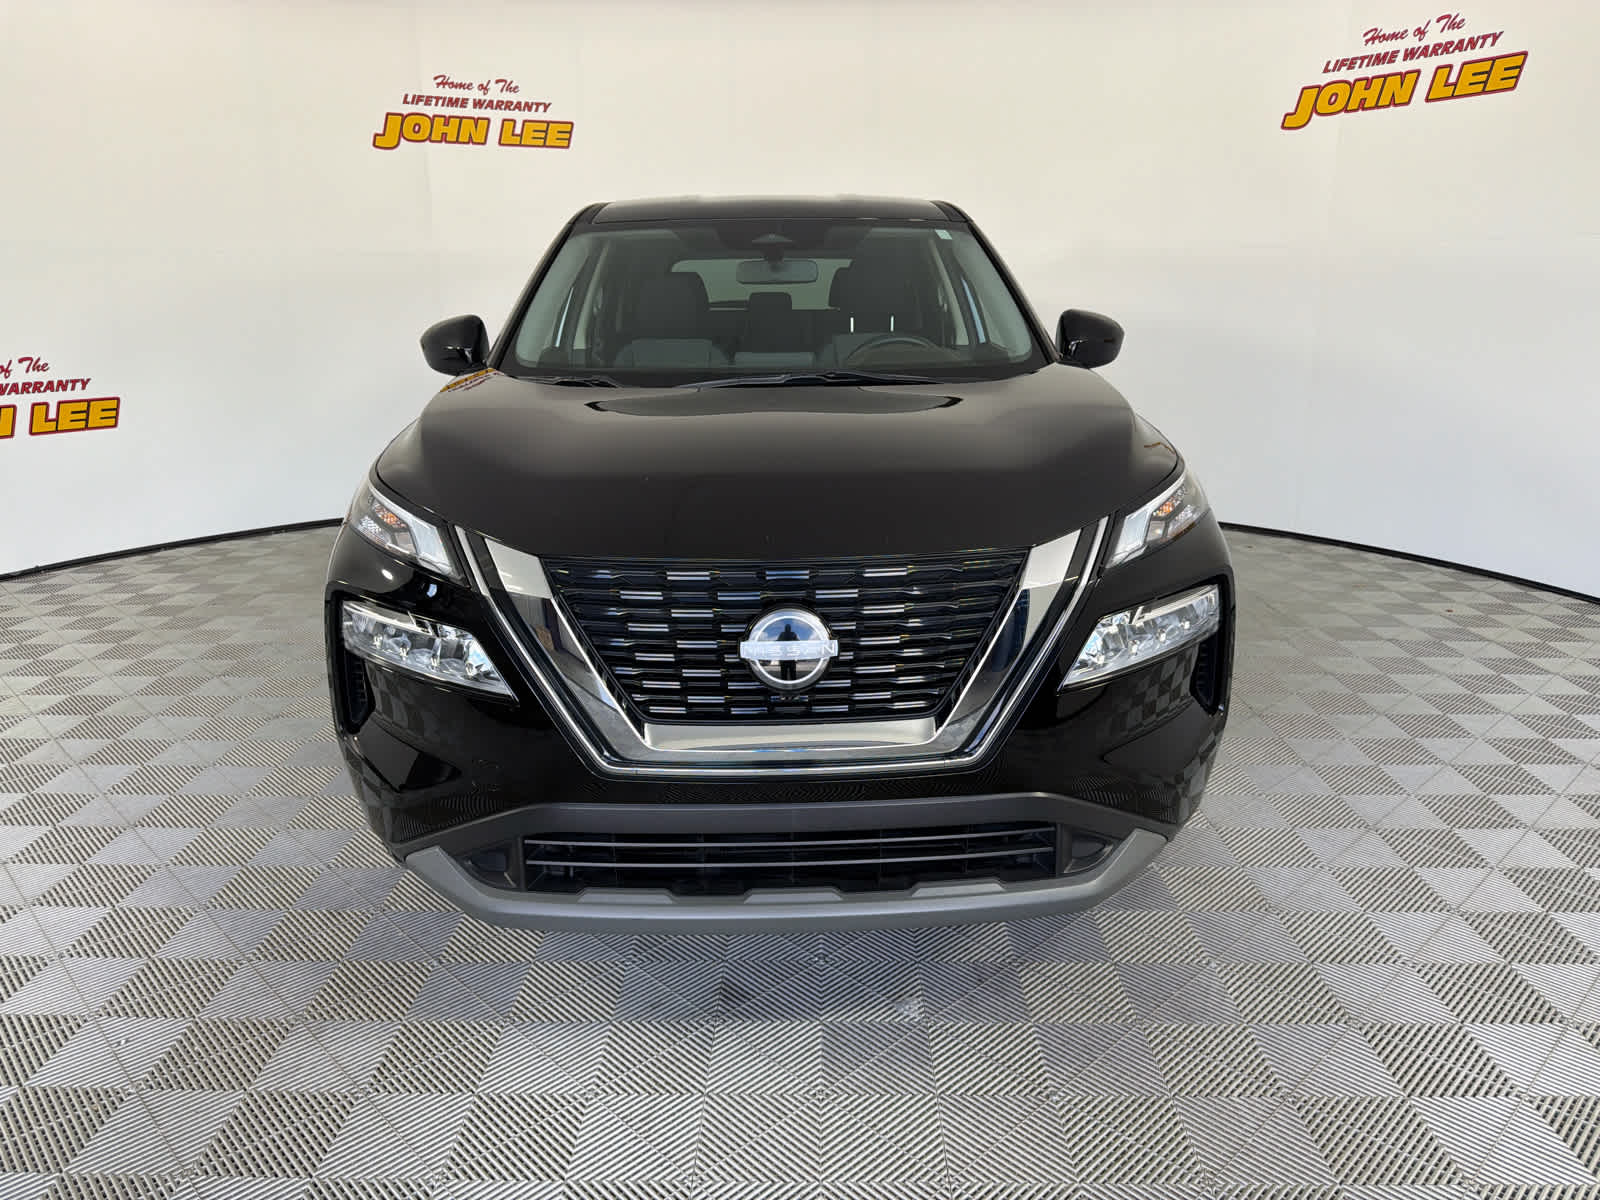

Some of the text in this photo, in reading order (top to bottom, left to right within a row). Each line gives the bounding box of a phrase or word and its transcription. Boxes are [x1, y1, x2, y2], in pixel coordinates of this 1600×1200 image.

[1362, 13, 1465, 46] Home of The
[1322, 31, 1504, 74] LIFETIME WARRANTY
[433, 74, 520, 95] Home of The
[1281, 51, 1528, 130] JOHN LEE
[402, 93, 552, 113] LIFETIME WARRANTY
[372, 111, 574, 150] JOHN LEE
[18, 356, 50, 374] The
[29, 396, 120, 436] LEE
